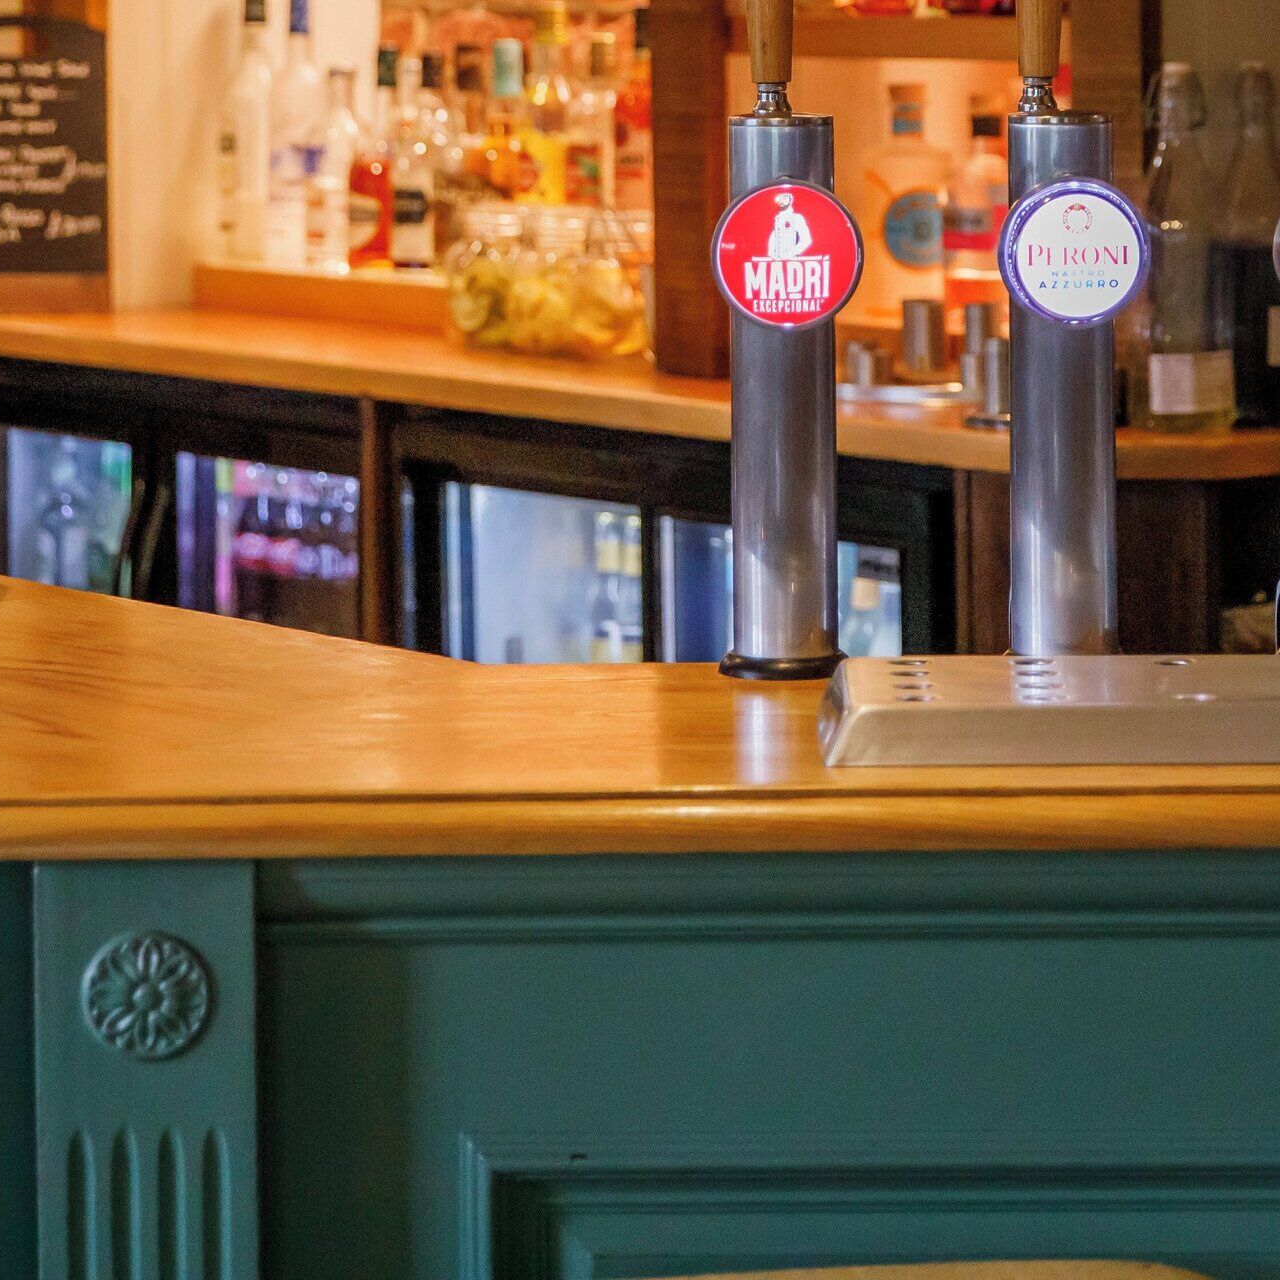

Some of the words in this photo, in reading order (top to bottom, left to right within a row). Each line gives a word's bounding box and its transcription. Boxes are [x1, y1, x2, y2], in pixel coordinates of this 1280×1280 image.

[1028, 244, 1128, 266] PERONI
[1039, 279, 1119, 289] AZZURRO
[753, 300, 821, 312] EXCEPCIONAL
